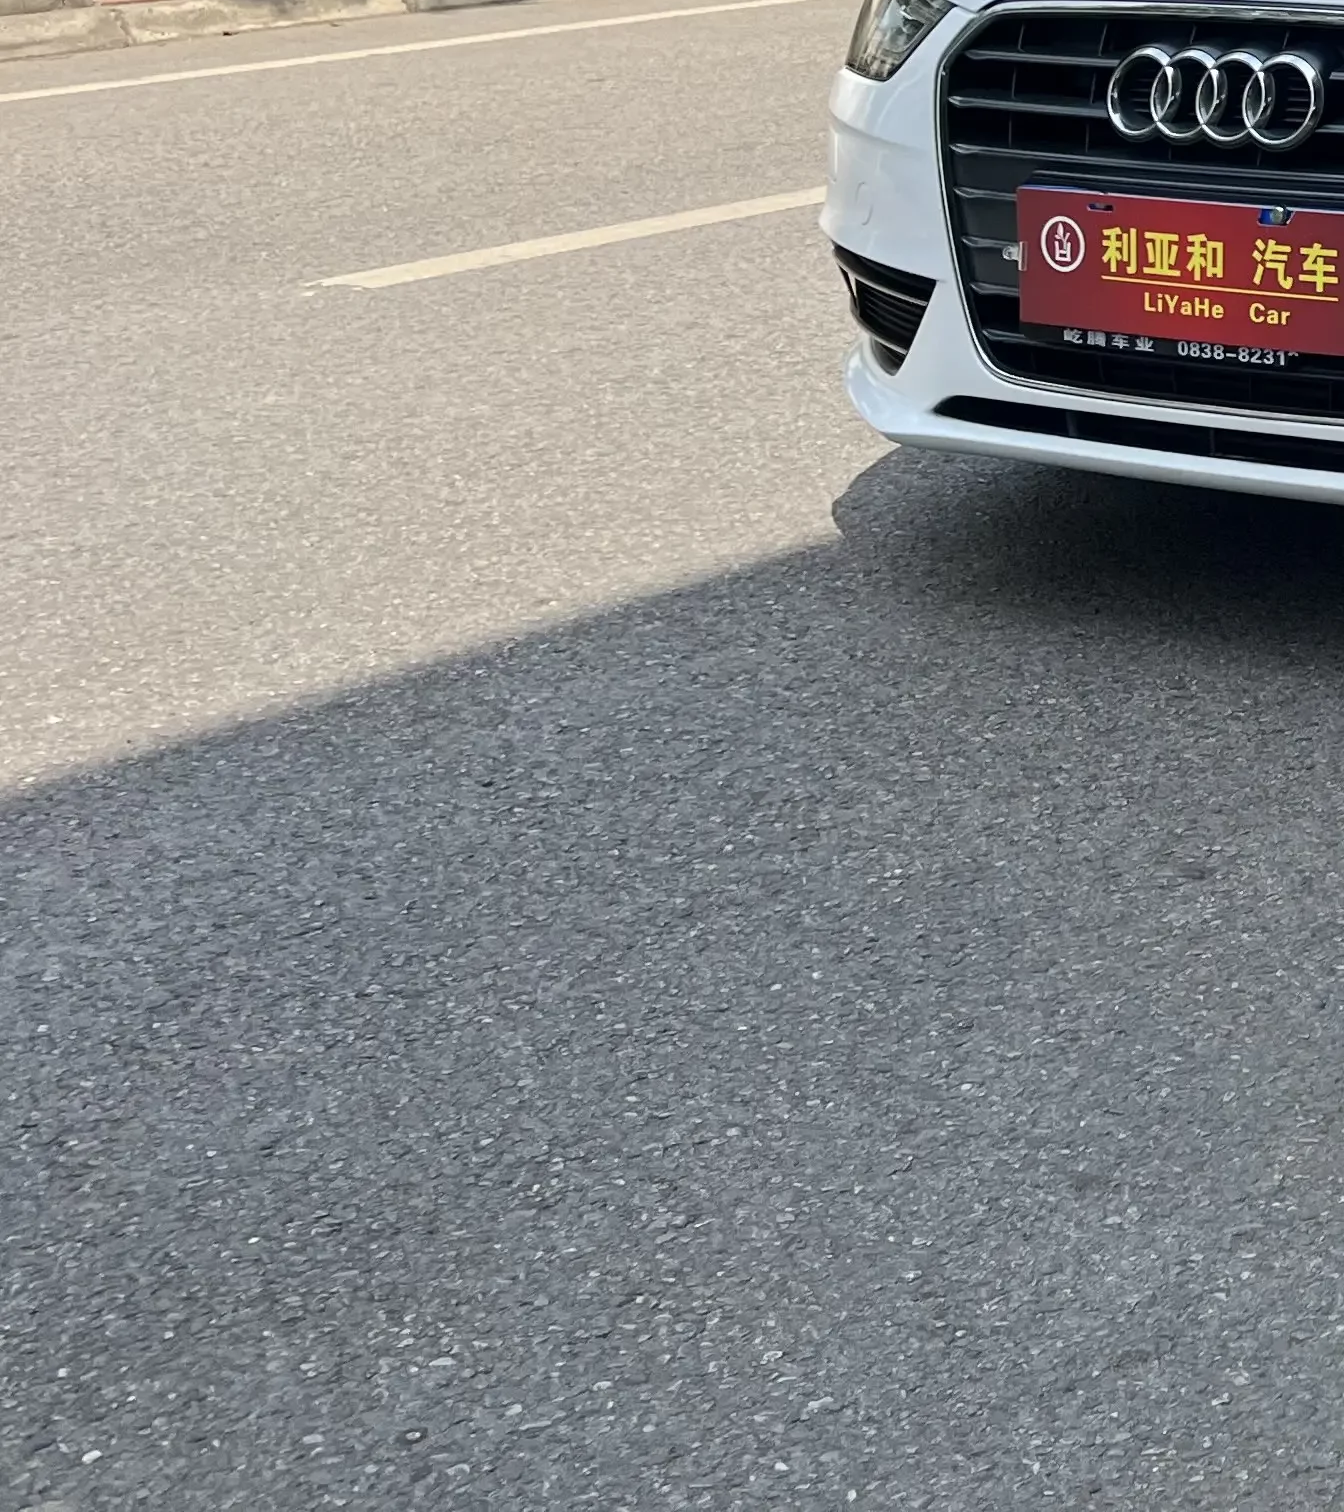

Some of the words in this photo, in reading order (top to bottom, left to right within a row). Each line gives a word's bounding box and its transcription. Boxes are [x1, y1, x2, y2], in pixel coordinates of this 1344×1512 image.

[1102, 227, 1224, 281] 利亚和
[1251, 238, 1339, 292] 汽车
[1144, 291, 1224, 319] LiYaHe
[1249, 302, 1291, 325] Car
[1177, 341, 1299, 366] 0838-8231
